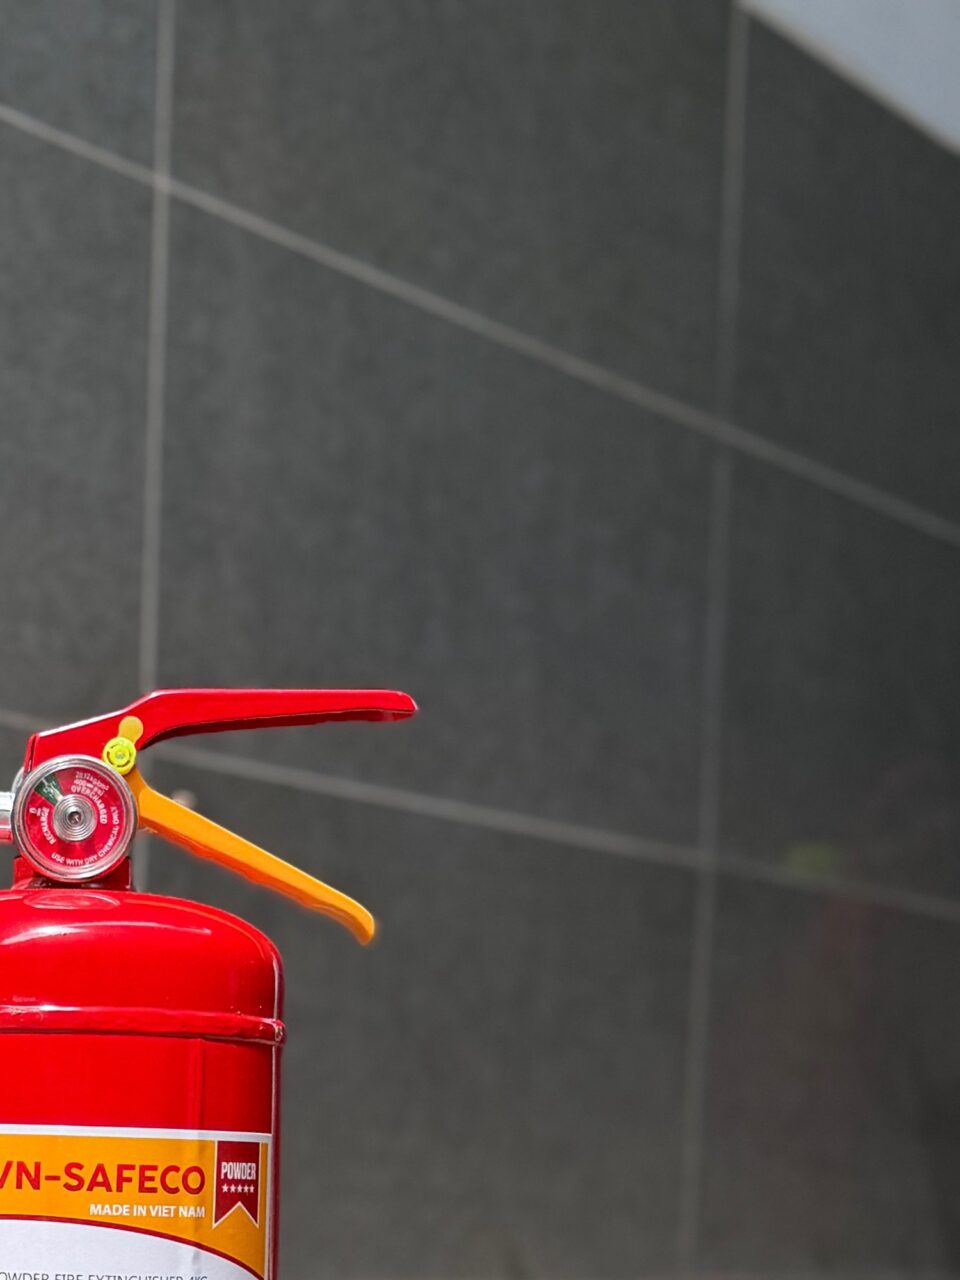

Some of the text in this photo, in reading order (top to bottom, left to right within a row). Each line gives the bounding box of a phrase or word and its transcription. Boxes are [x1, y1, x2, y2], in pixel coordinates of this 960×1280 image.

[71, 785, 107, 824] OVERCHARGED
[51, 806, 119, 866] USE WITH DRY CHEMICAL ONLY
[221, 1162, 256, 1180] POWDER
[90, 1204, 205, 1218] MADE IN VIET NAM
